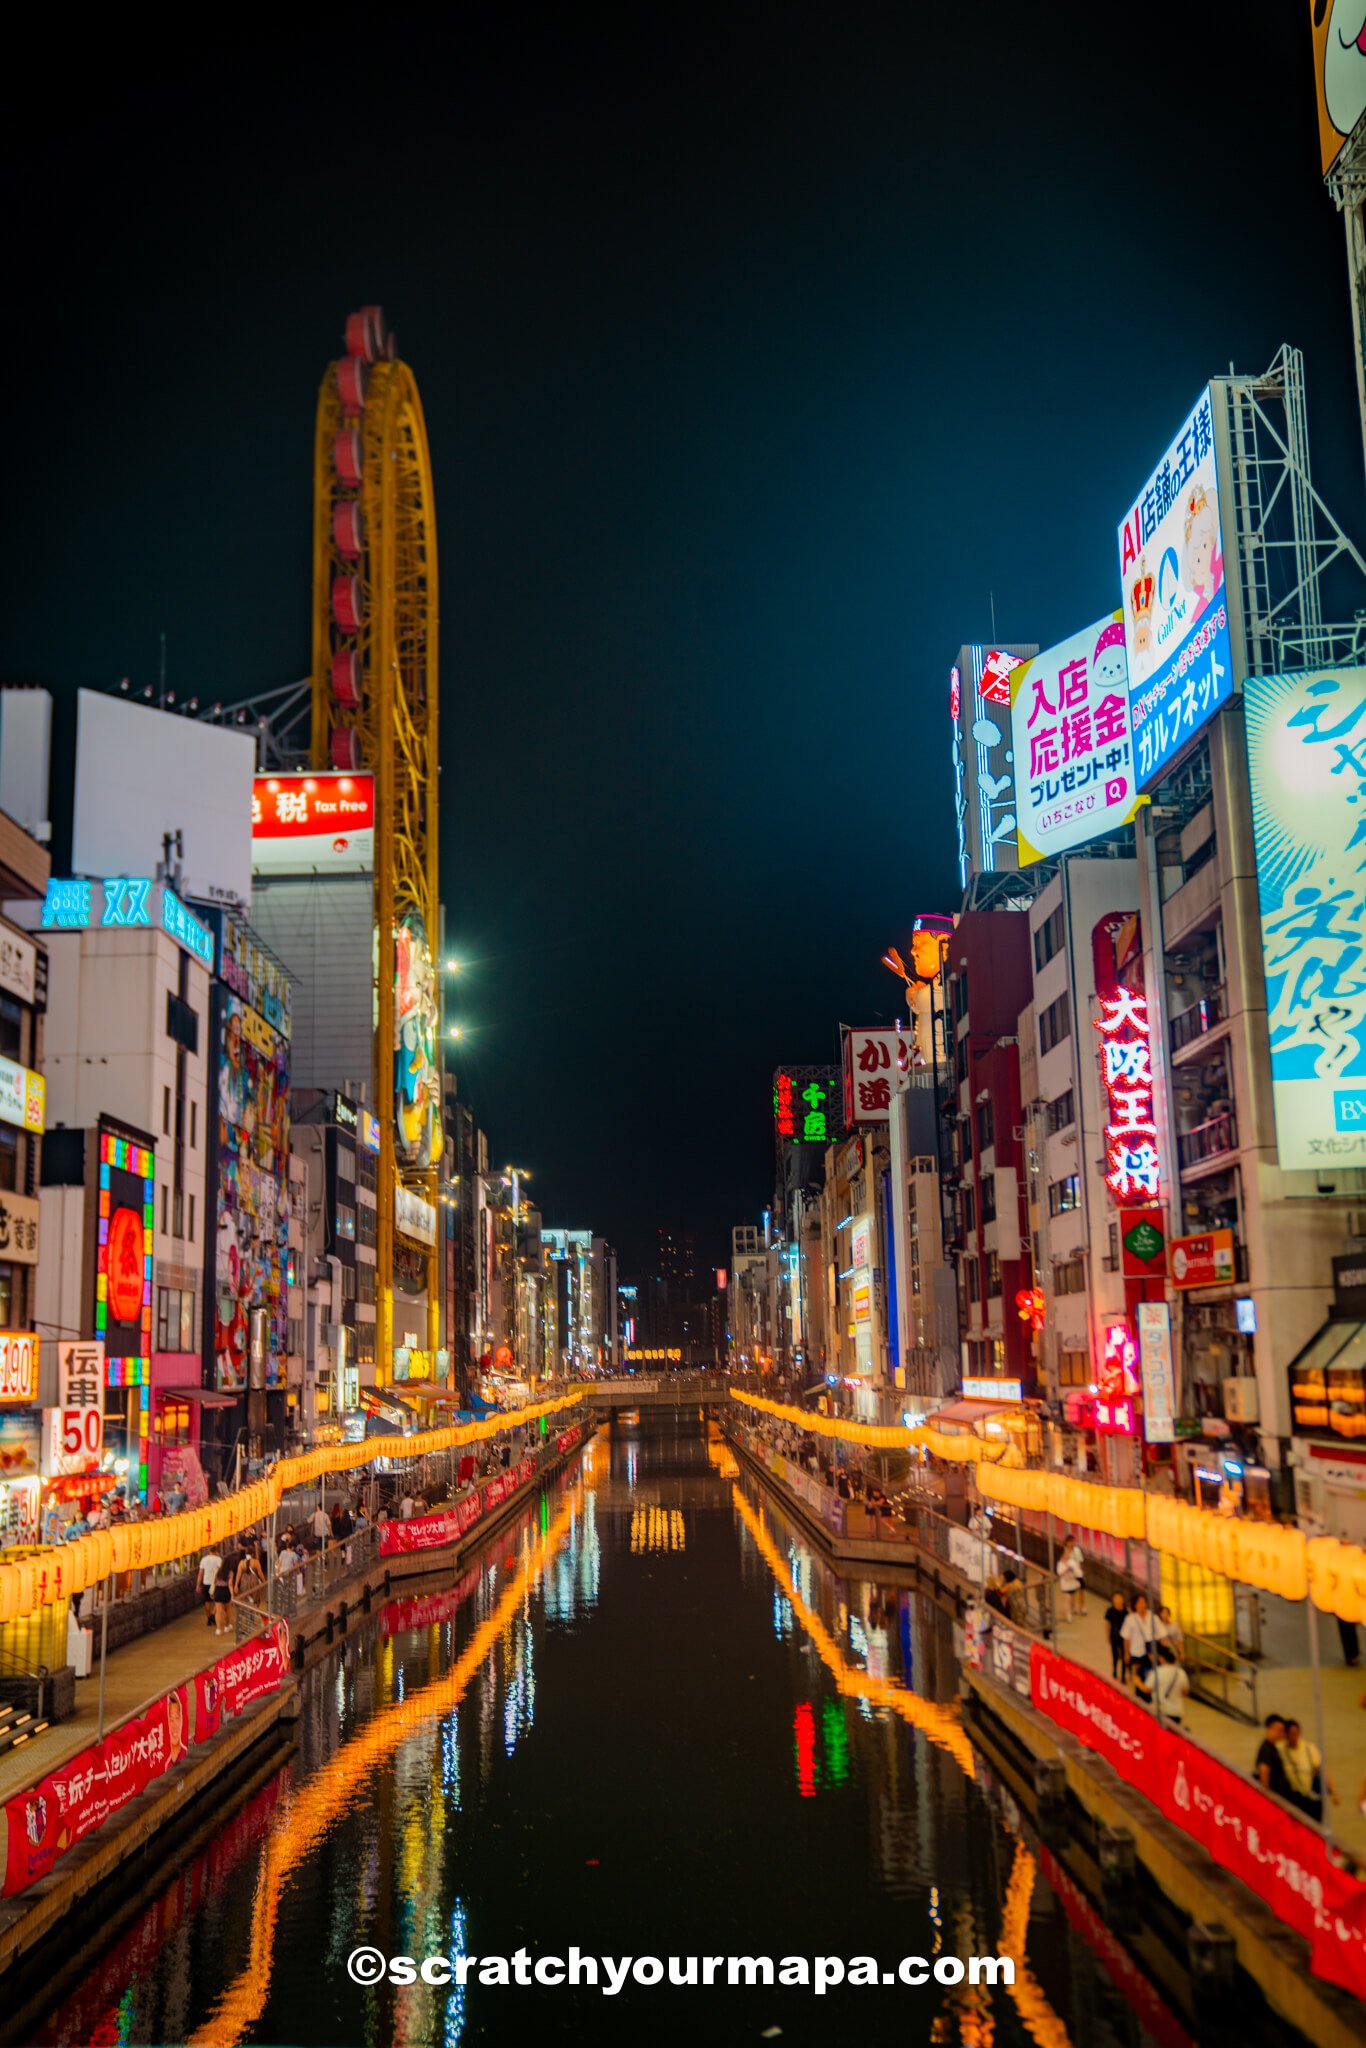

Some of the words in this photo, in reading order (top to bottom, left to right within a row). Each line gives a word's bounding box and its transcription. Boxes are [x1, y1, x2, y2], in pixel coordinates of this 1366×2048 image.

[1027, 657, 1089, 730] 入店
[1139, 650, 1224, 776] ガルフネット
[1030, 693, 1127, 780] 応援金
[314, 800, 337, 813] Tax
[340, 799, 368, 812] Free
[1042, 794, 1096, 829] いちこなび
[802, 1082, 827, 1136] 千房
[1096, 986, 1159, 1197] 大阪王将
[65, 1348, 99, 1408] 伝串
[63, 1409, 101, 1454] 50
